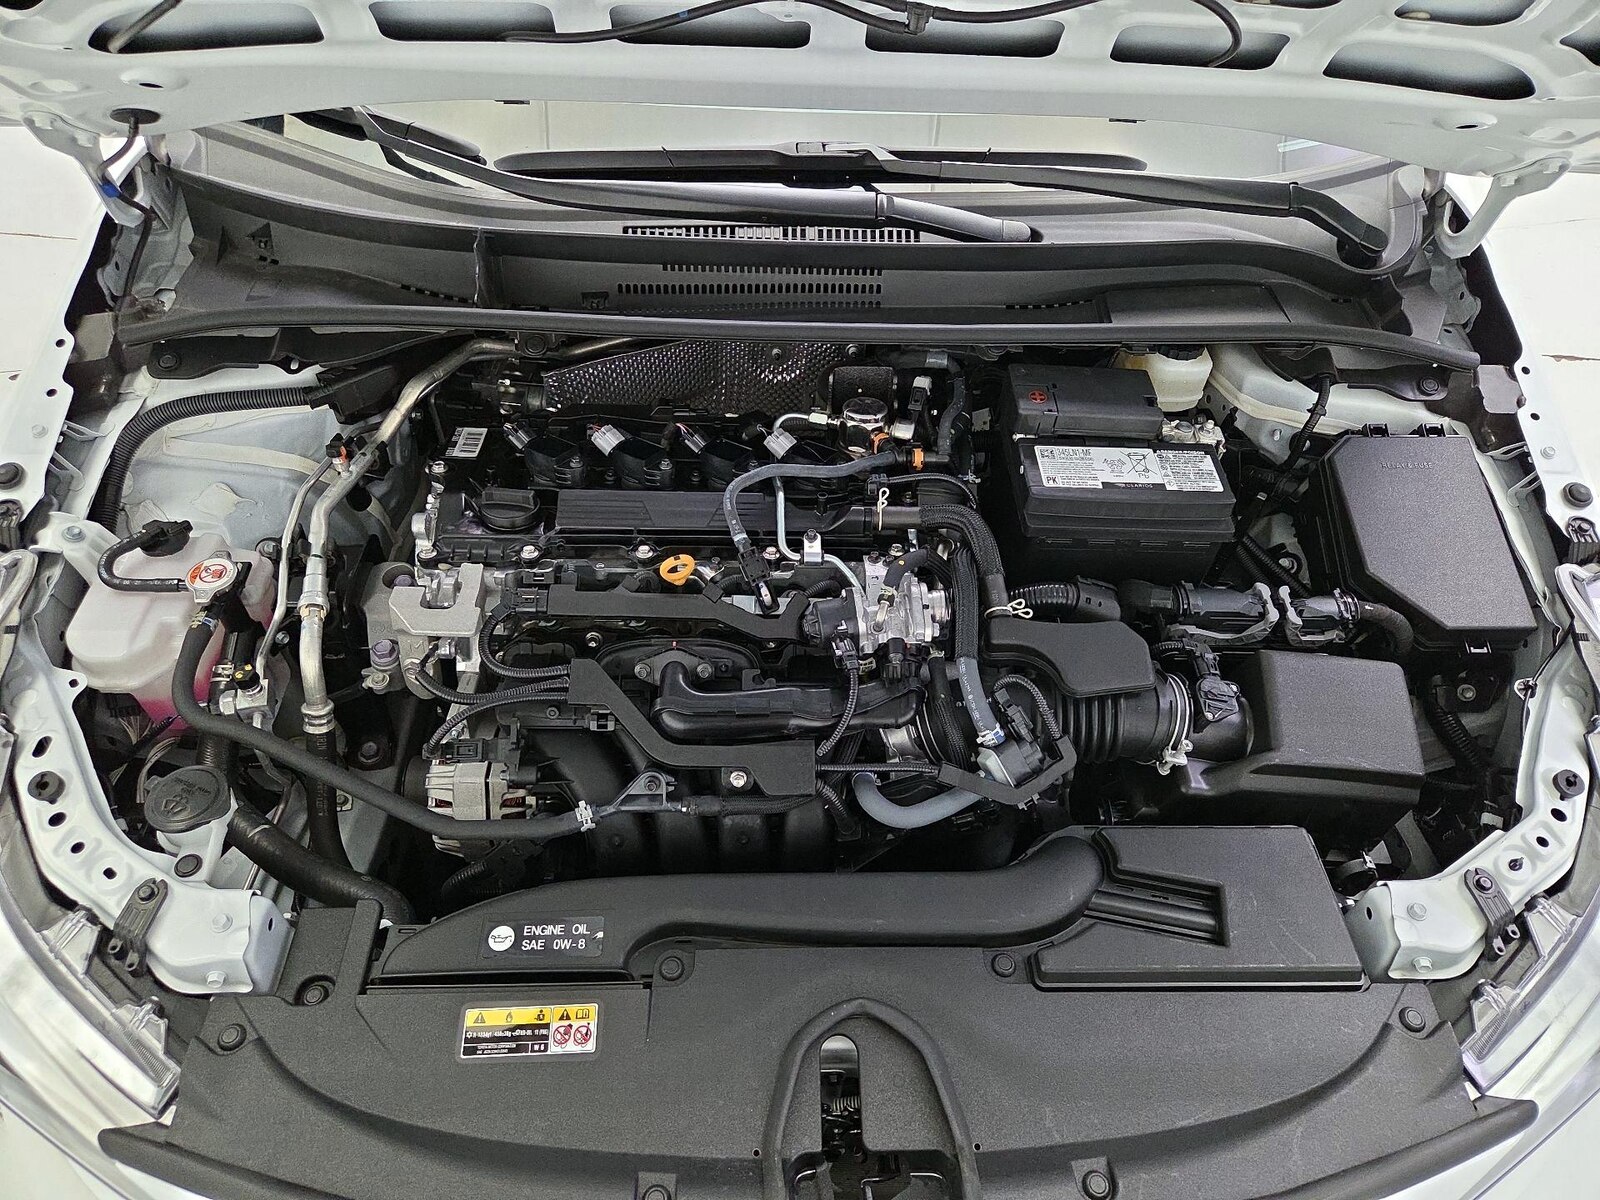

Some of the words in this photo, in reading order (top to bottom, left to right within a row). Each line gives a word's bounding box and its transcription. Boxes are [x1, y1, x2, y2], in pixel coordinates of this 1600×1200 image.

[1046, 476, 1057, 485] PK
[523, 924, 565, 936] ENGINE
[572, 923, 591, 935] OIL
[521, 939, 546, 951] SAE
[553, 938, 586, 950] 0W-8
